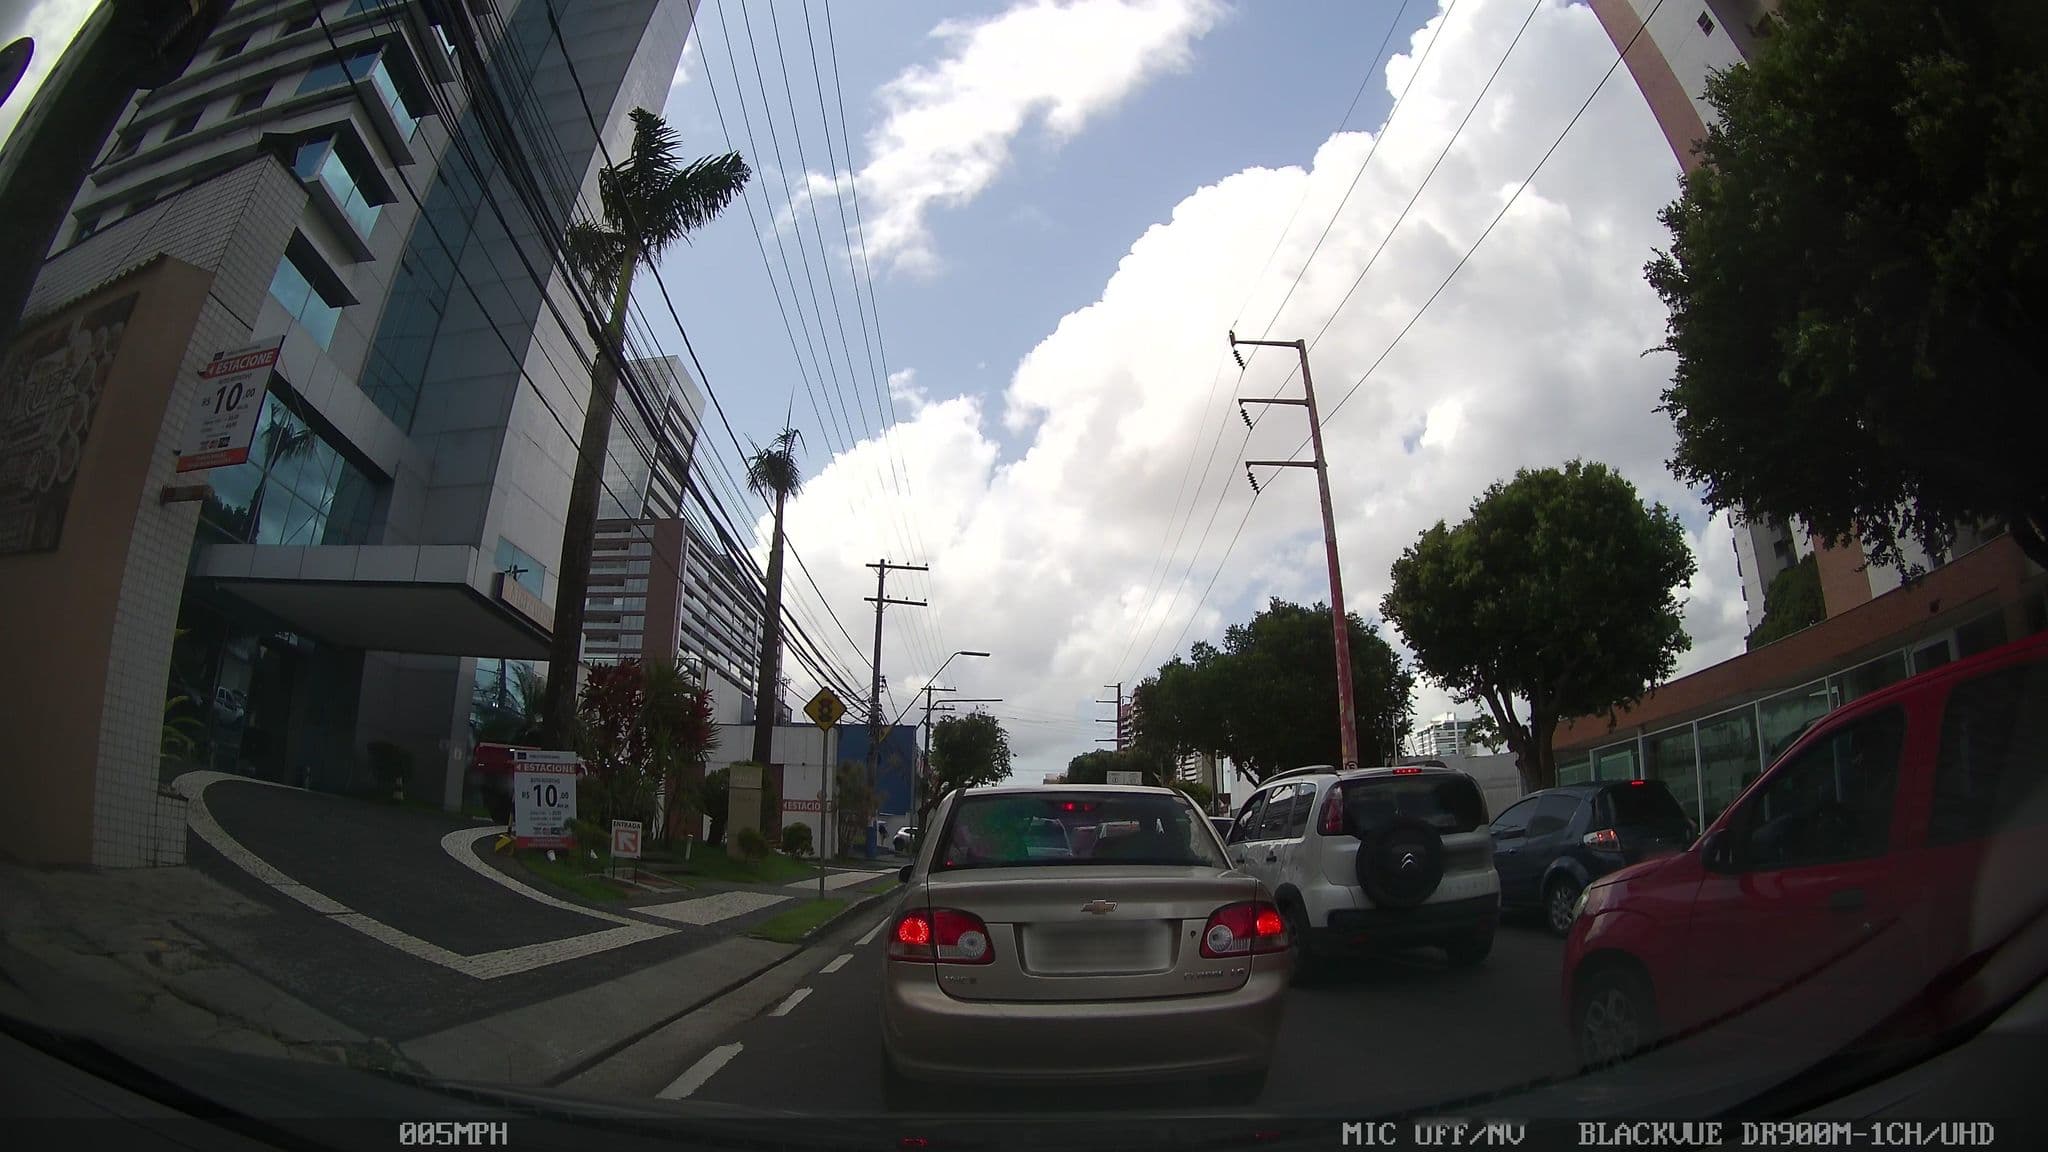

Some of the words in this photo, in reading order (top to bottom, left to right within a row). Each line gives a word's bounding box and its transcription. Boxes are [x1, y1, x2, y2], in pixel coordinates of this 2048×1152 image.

[216, 351, 274, 373] ESTACIONE
[524, 763, 575, 773] ESTACIONE
[613, 821, 641, 829] ENTRADA
